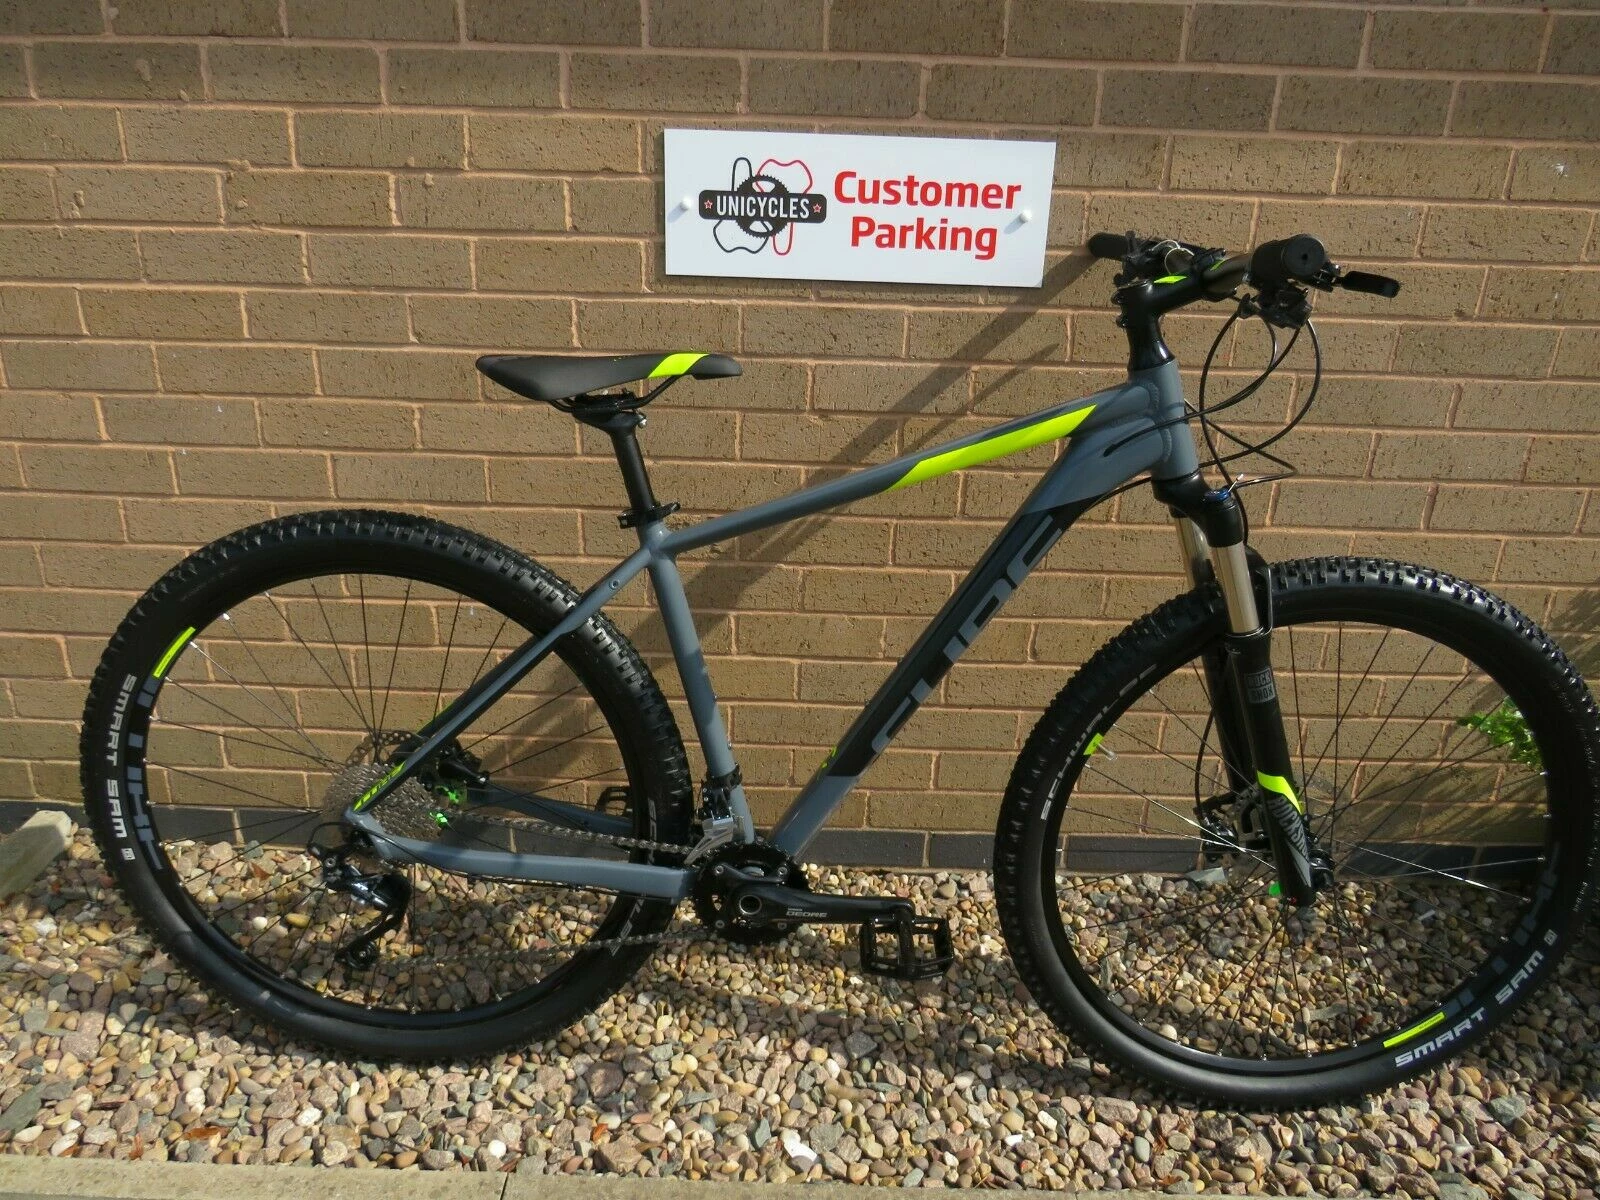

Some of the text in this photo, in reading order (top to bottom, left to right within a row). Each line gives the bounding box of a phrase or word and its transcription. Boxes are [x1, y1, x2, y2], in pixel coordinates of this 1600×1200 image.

[716, 195, 811, 219] UNICYCLES
[834, 171, 1022, 209] Customer
[850, 216, 998, 261] Parking
[104, 673, 138, 767] SMART
[106, 779, 128, 839] SAM
[1394, 950, 1544, 1068] SMART SAM
